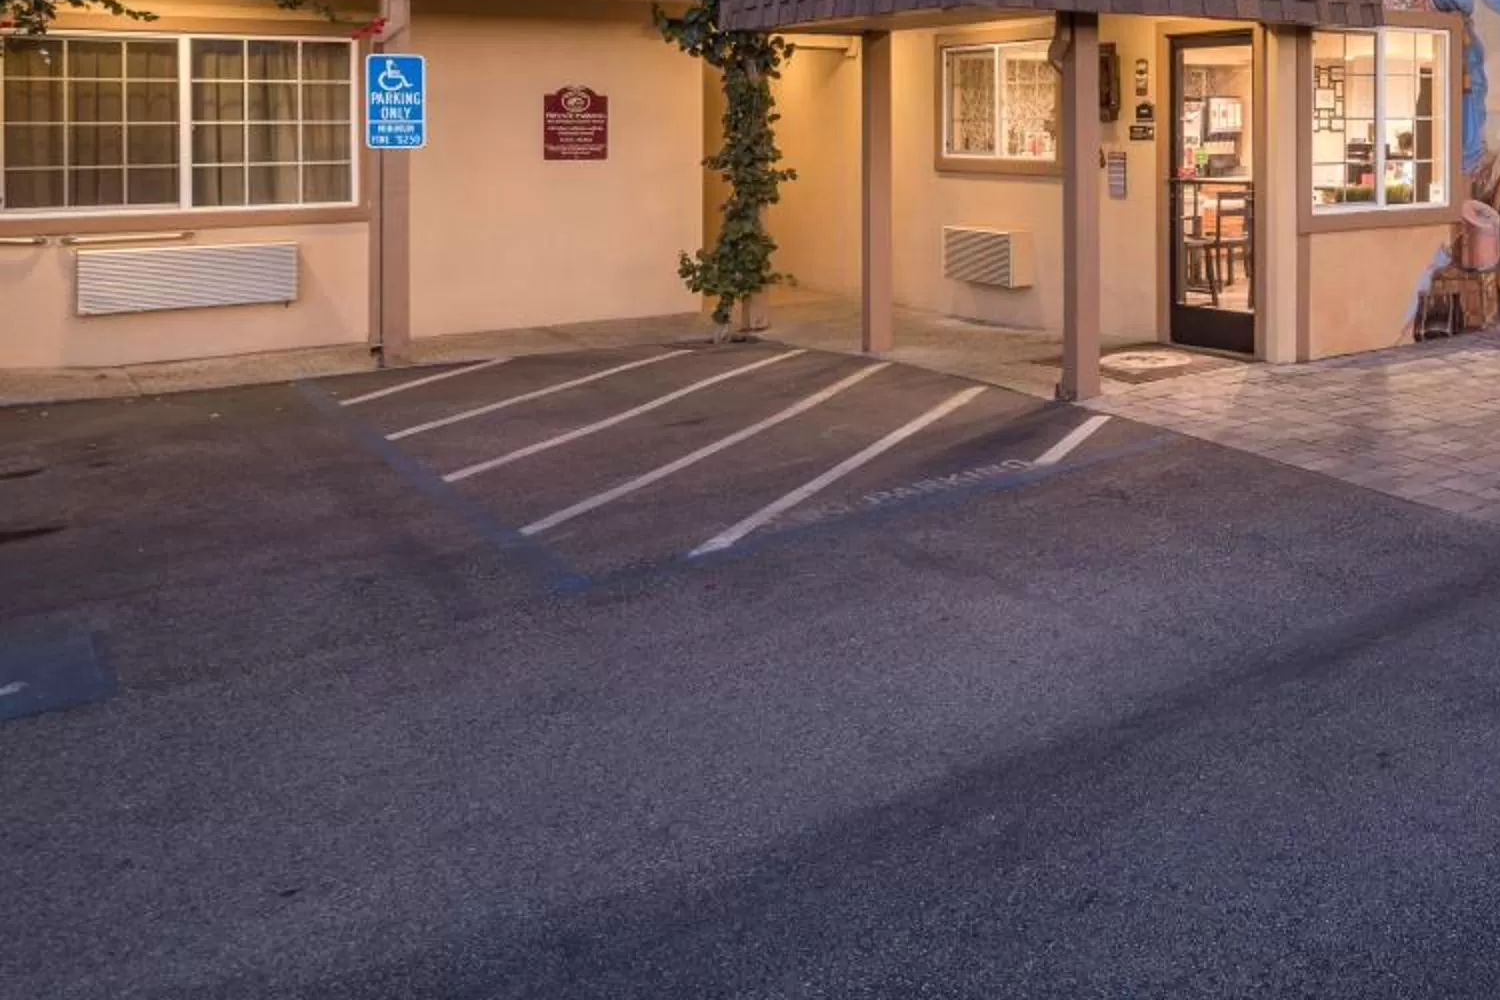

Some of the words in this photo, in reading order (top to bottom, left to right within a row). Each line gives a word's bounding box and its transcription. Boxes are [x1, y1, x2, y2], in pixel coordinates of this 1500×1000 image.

[371, 92, 421, 105] PARKING
[381, 107, 412, 119] ONLY
[377, 124, 415, 133] MINIMUM
[371, 136, 389, 145] FINE
